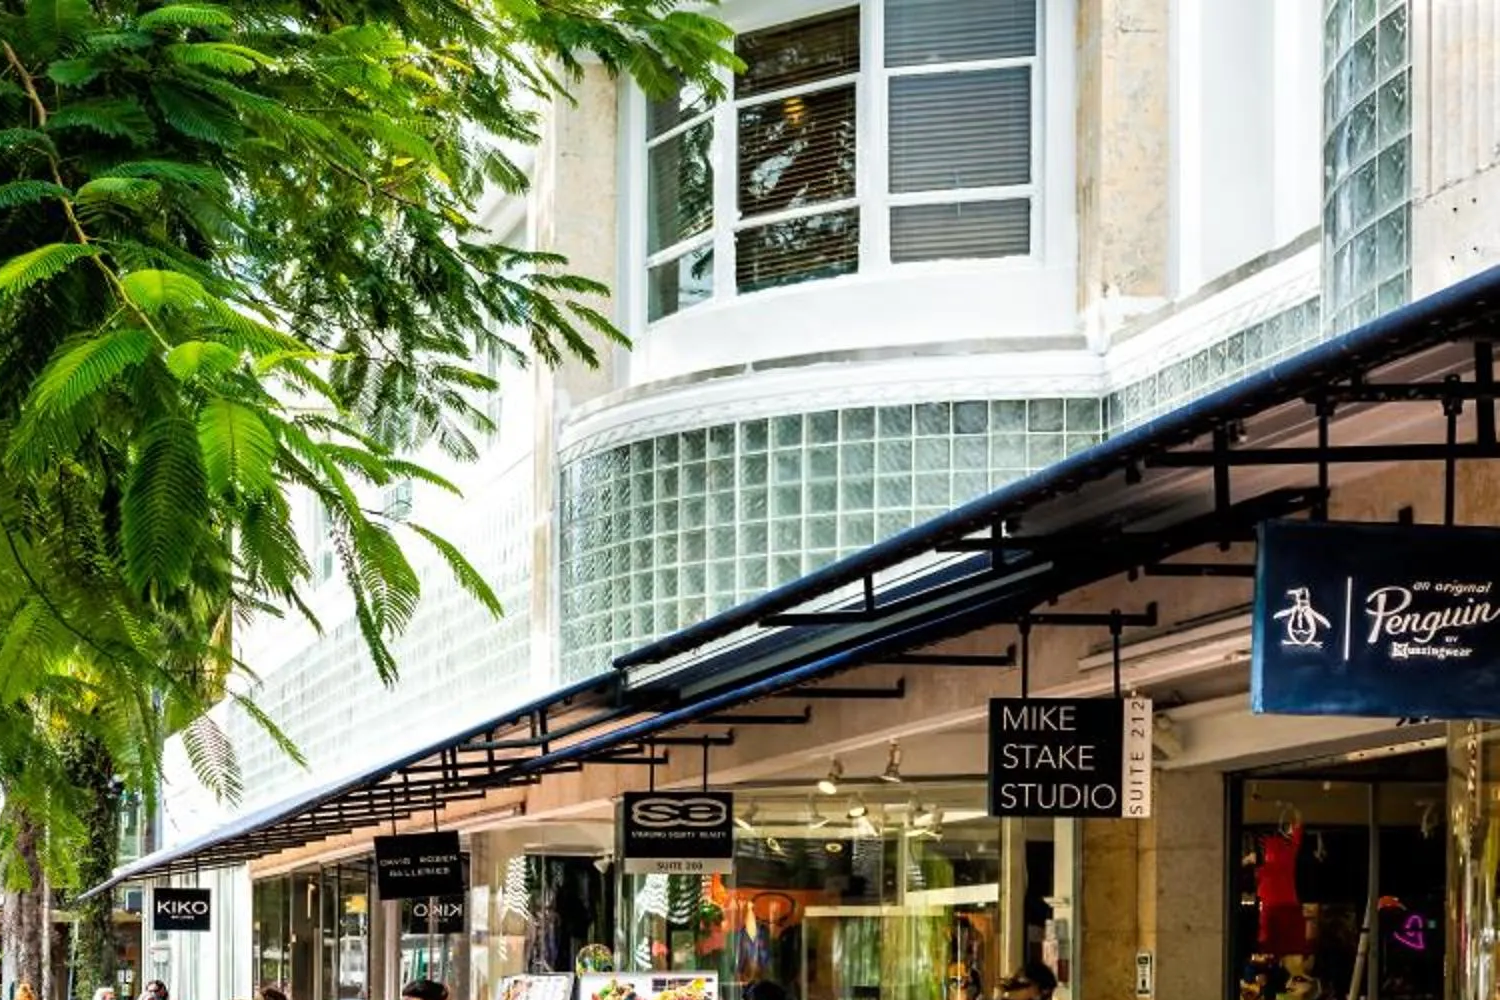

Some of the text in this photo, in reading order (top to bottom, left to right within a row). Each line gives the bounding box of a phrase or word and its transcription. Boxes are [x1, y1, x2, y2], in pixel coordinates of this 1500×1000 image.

[1412, 579, 1493, 597] an original
[1365, 586, 1500, 644] Penguin
[1002, 705, 1077, 731] MIKE
[1002, 743, 1096, 771] STAKE
[1130, 700, 1145, 815] SUITE 212
[1001, 783, 1117, 809] STUDIO
[157, 900, 209, 915] KIKO
